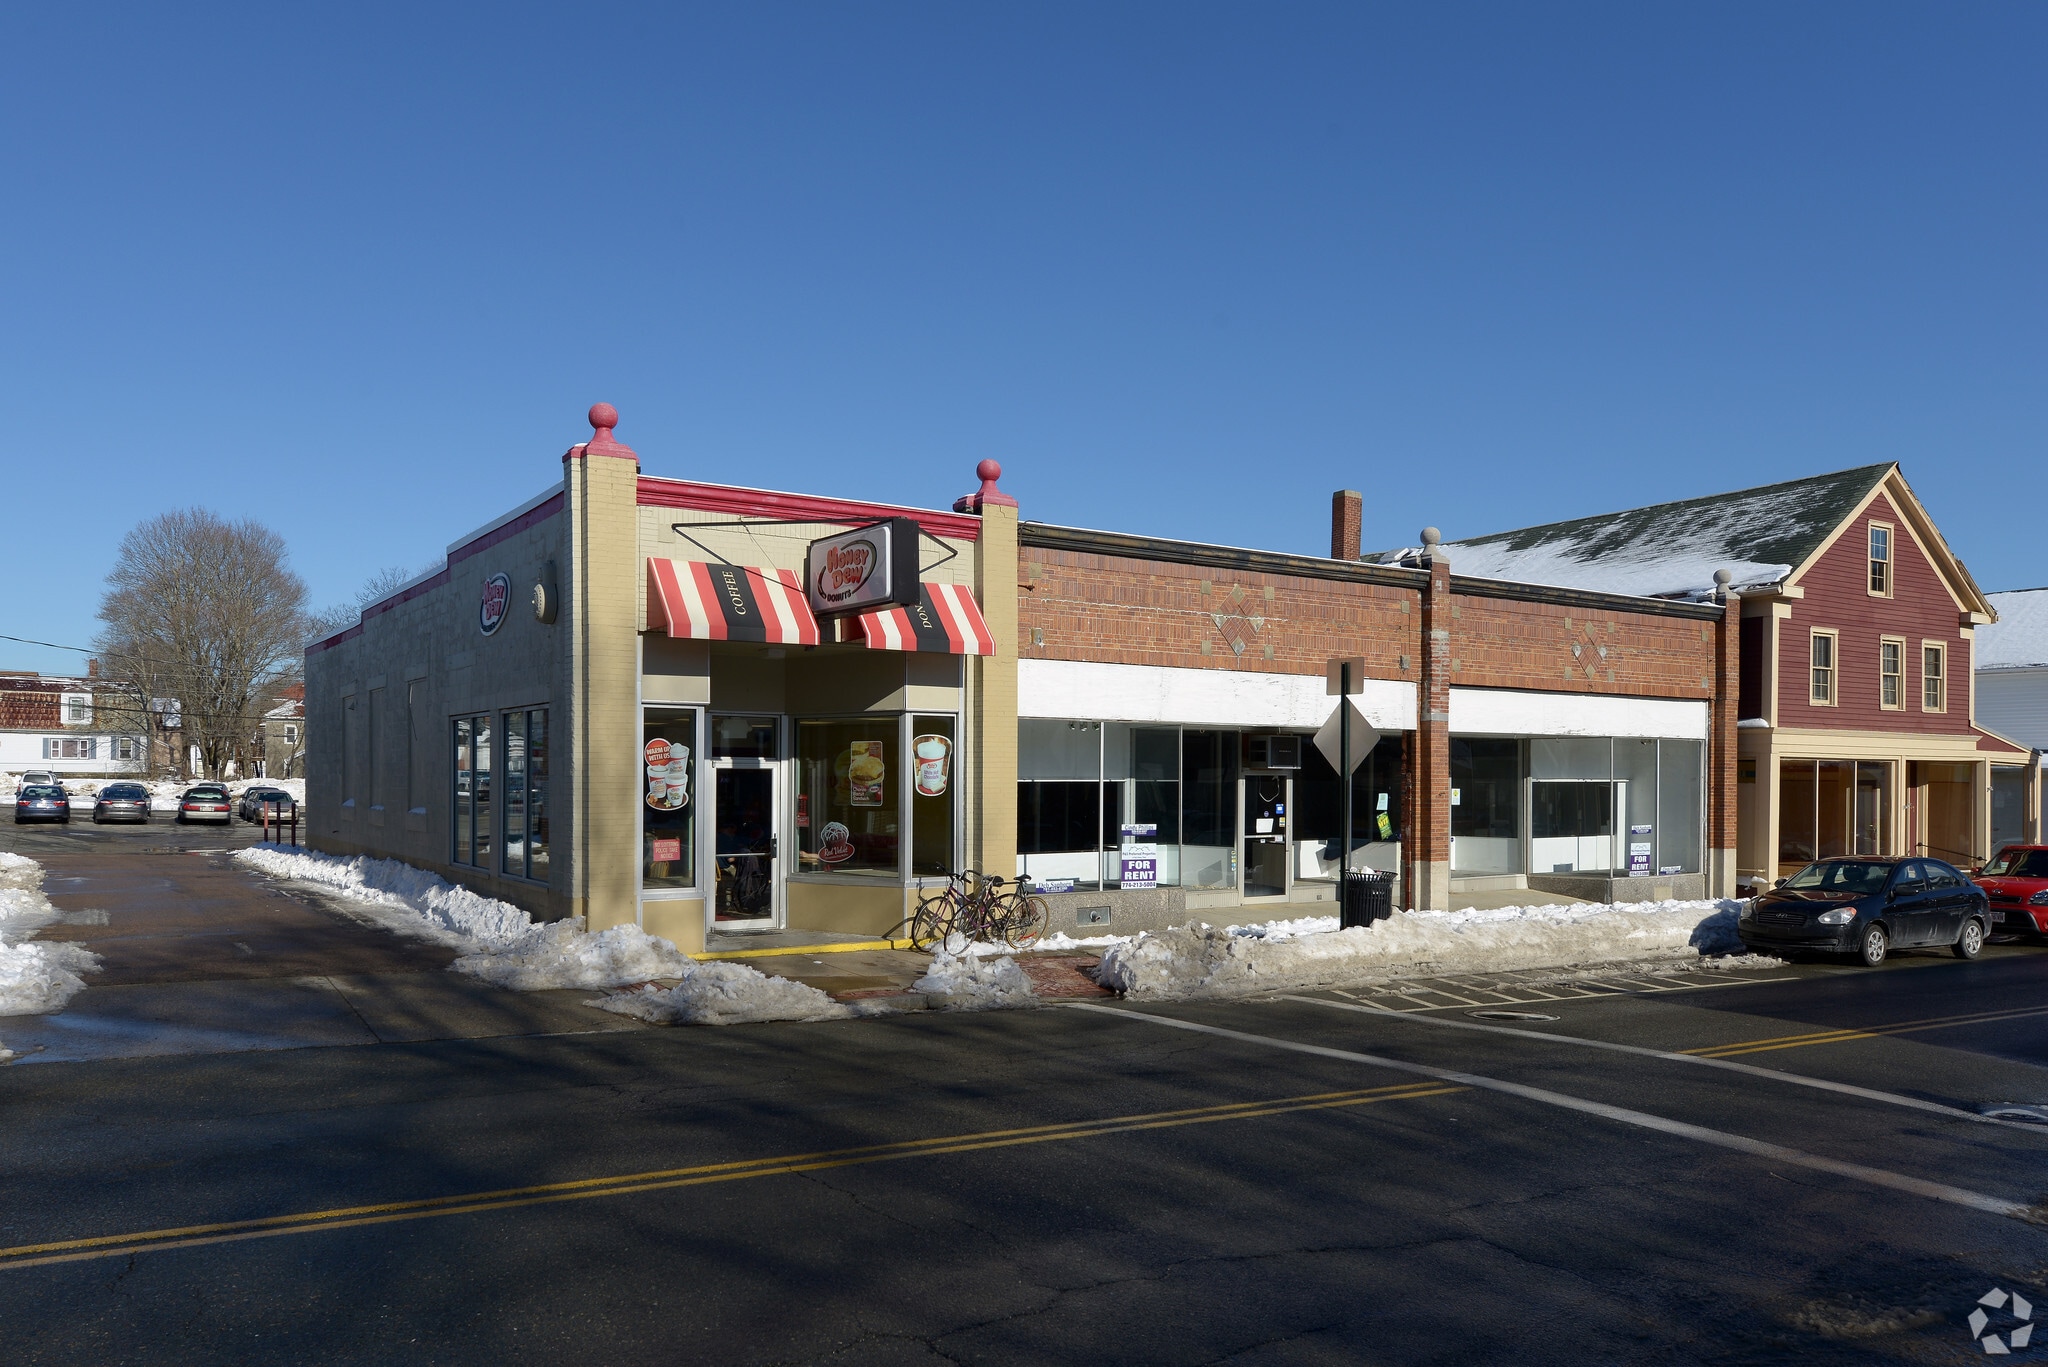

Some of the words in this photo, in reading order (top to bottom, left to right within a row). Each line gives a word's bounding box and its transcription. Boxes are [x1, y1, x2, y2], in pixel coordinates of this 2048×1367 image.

[722, 571, 746, 615] COFFEE
[827, 589, 852, 602] DONUTS
[914, 601, 932, 628] DON
[647, 747, 663, 755] WARM
[1128, 861, 1151, 870] FOR
[1631, 863, 1649, 871] RENT
[1125, 871, 1155, 880] RENT
